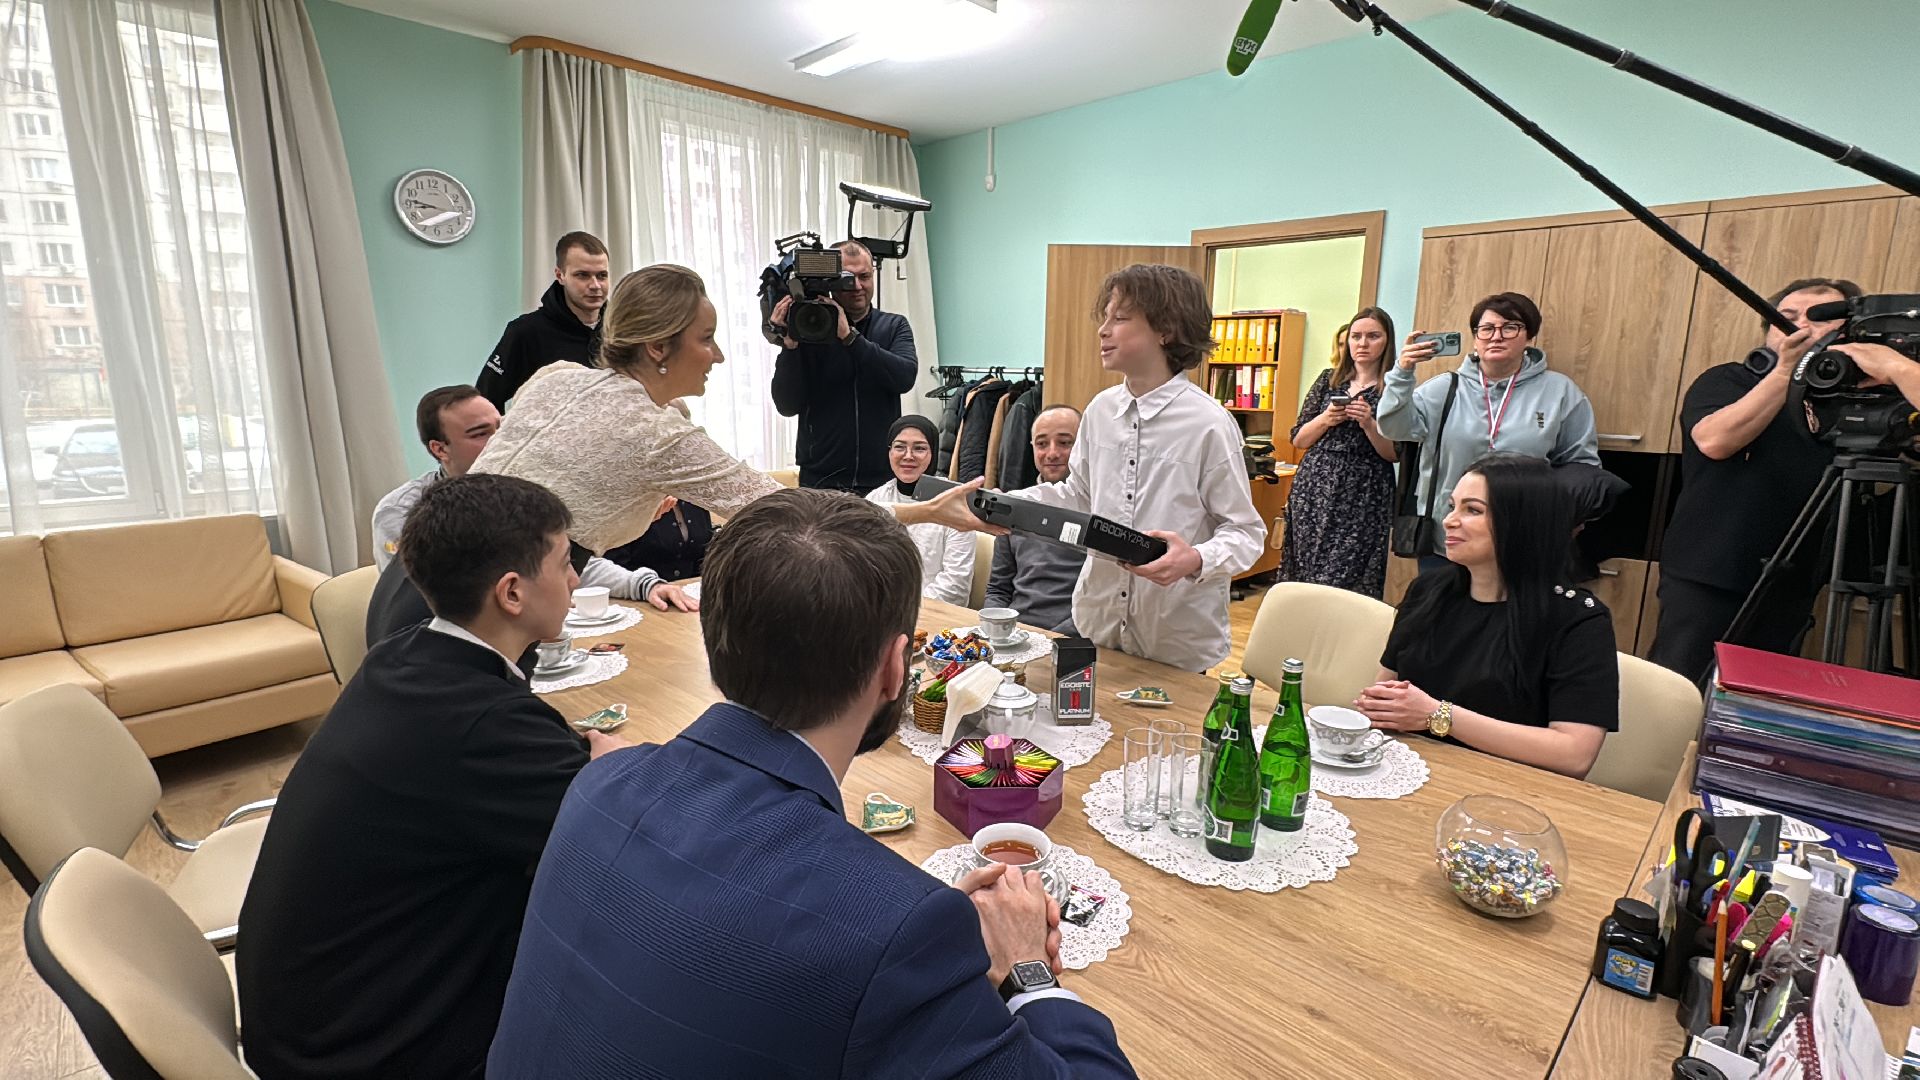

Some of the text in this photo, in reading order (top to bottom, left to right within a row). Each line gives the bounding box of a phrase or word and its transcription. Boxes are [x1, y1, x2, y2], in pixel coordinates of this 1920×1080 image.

[415, 180, 424, 190] 11
[428, 179, 439, 189] 12
[444, 184, 448, 193] 1
[407, 188, 418, 198] 10
[452, 194, 459, 203] 2
[405, 199, 412, 209] 9
[410, 212, 417, 221] 8
[433, 226, 440, 236] 6
[447, 225, 453, 234] 5
[1794, 352, 1815, 380] Canon
